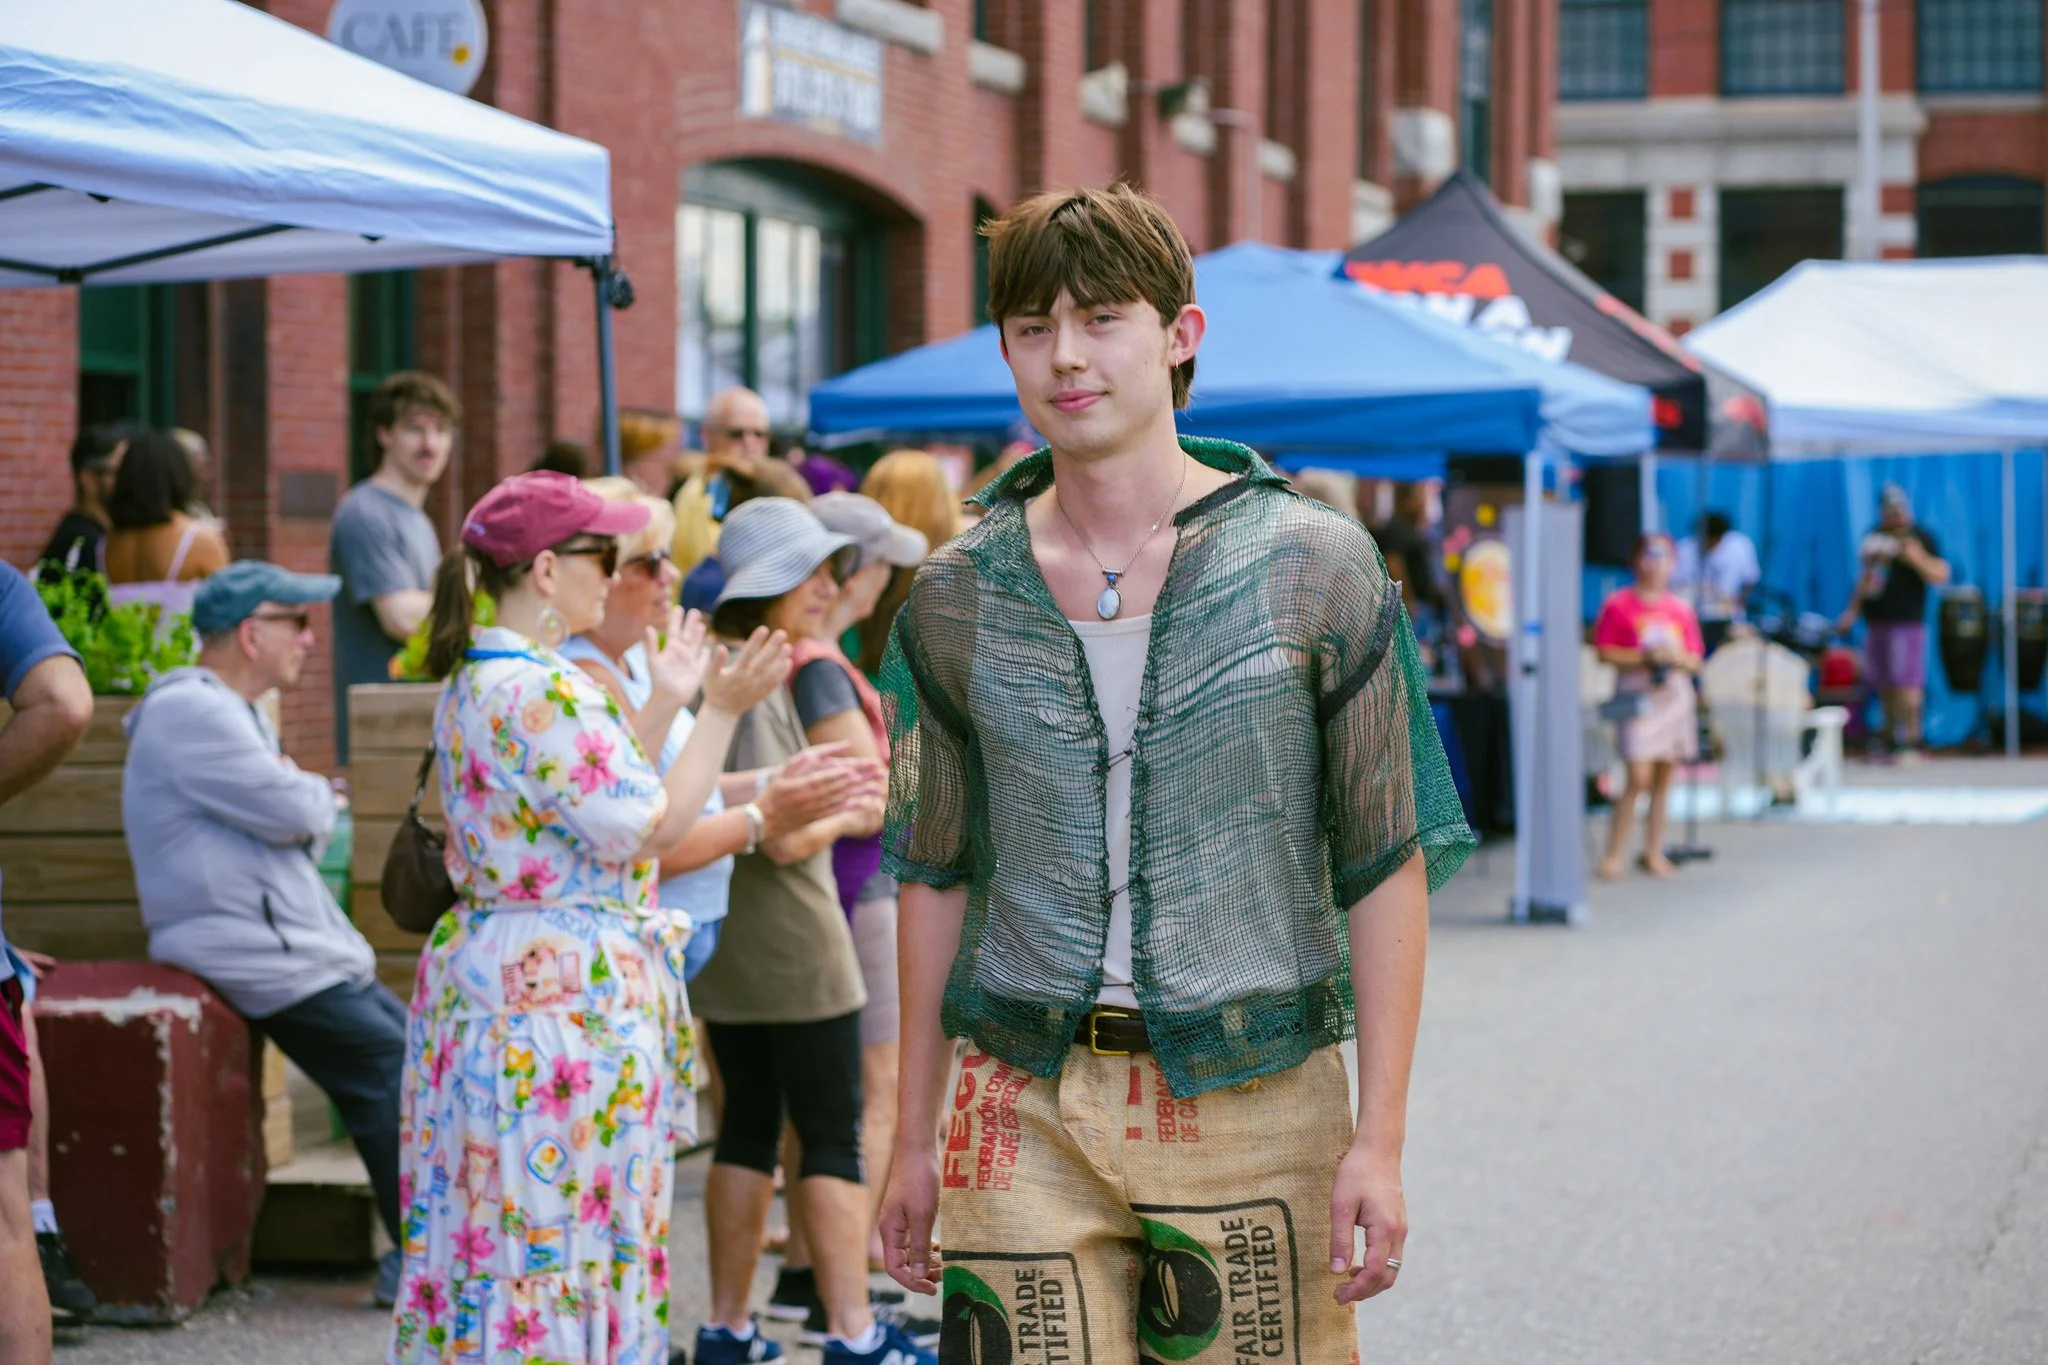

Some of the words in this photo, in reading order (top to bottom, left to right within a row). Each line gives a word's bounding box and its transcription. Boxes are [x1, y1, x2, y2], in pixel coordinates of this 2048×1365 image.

[976, 1095, 998, 1190] FEDERACIÓN
[1179, 1122, 1200, 1142] DE
[994, 1172, 1012, 1191] DE
[1220, 1218, 1252, 1302] TRADE
[1251, 1225, 1284, 1357] CERTIFIED
[1016, 1269, 1041, 1353] TRADE
[1232, 1309, 1259, 1365] FAIR
